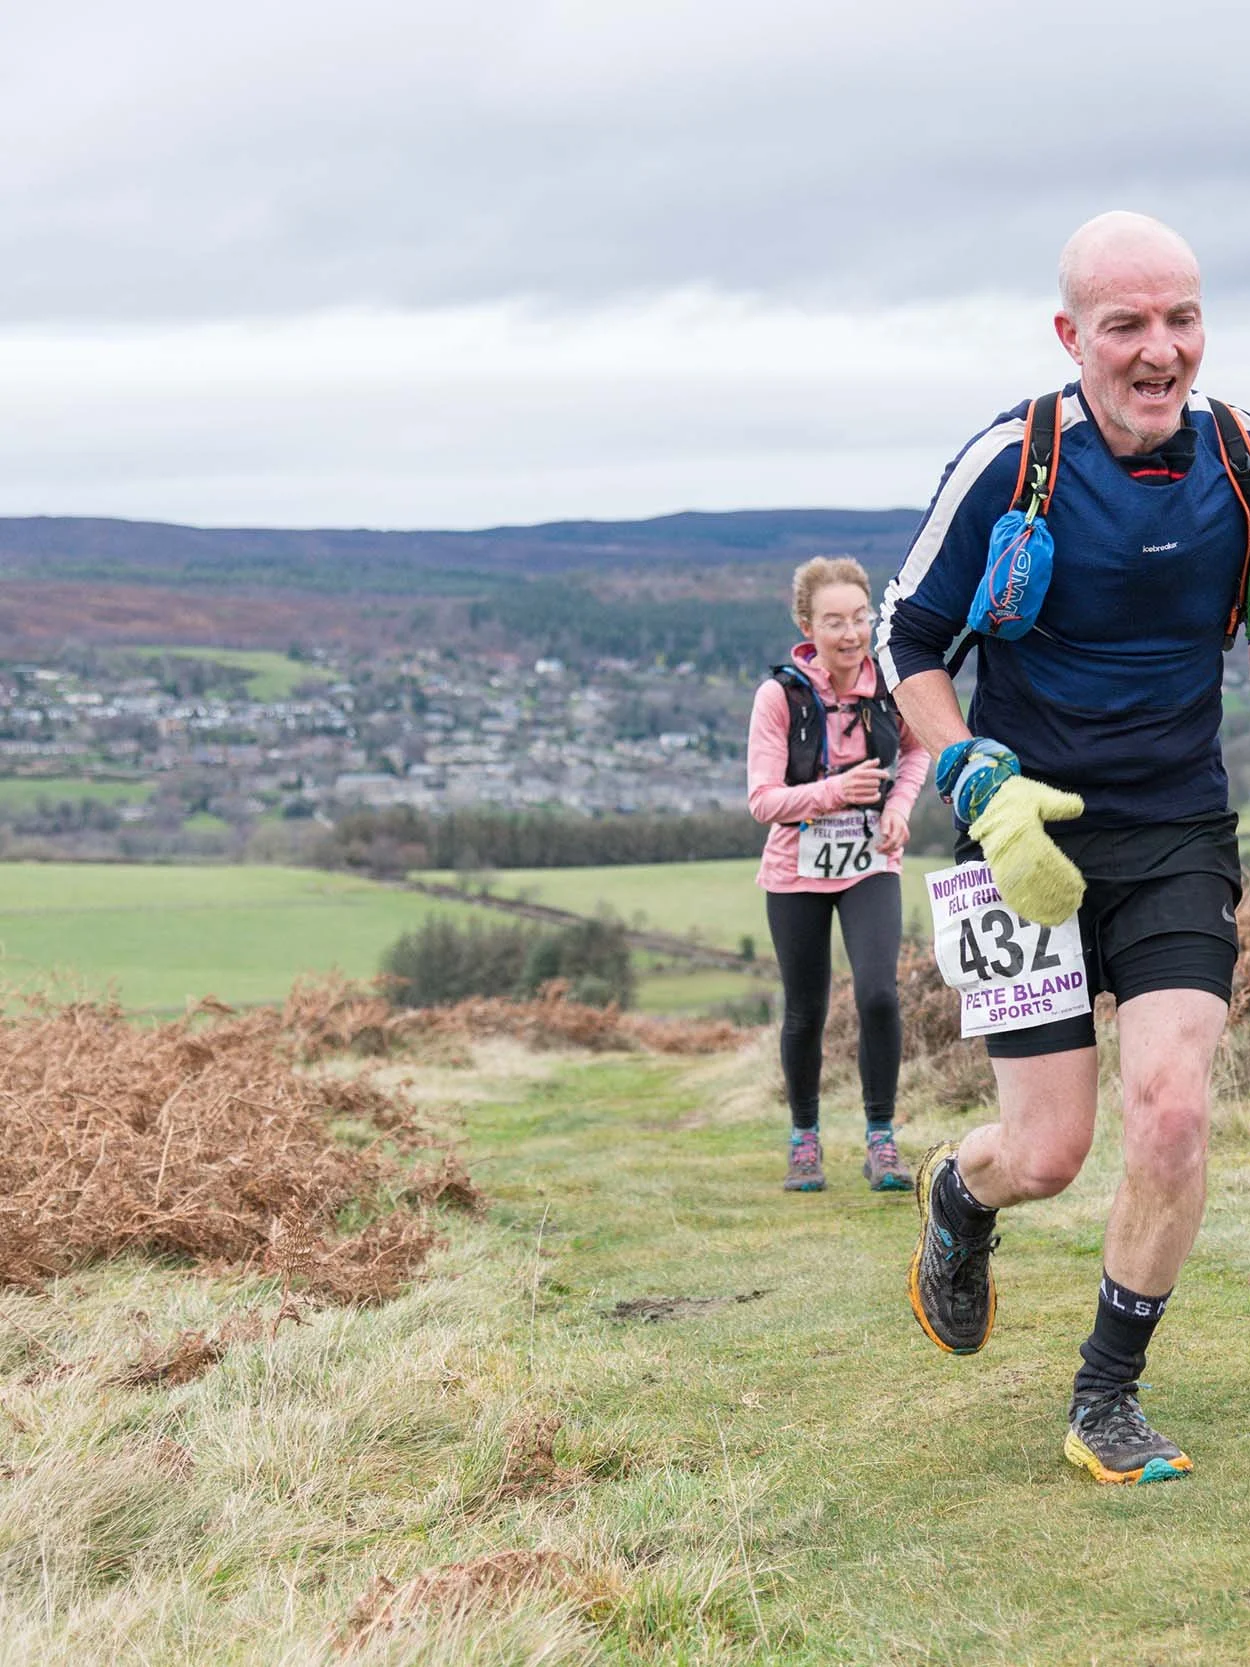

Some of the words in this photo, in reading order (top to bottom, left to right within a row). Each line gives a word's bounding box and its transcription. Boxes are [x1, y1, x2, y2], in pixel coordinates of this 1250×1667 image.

[814, 828, 831, 838] FELL
[814, 841, 872, 878] 476
[949, 894, 968, 916] FELL
[959, 909, 1061, 981] 432
[966, 987, 1006, 1010] PETE
[1013, 971, 1083, 1002] BLAND
[989, 998, 1053, 1022] SPORTS
